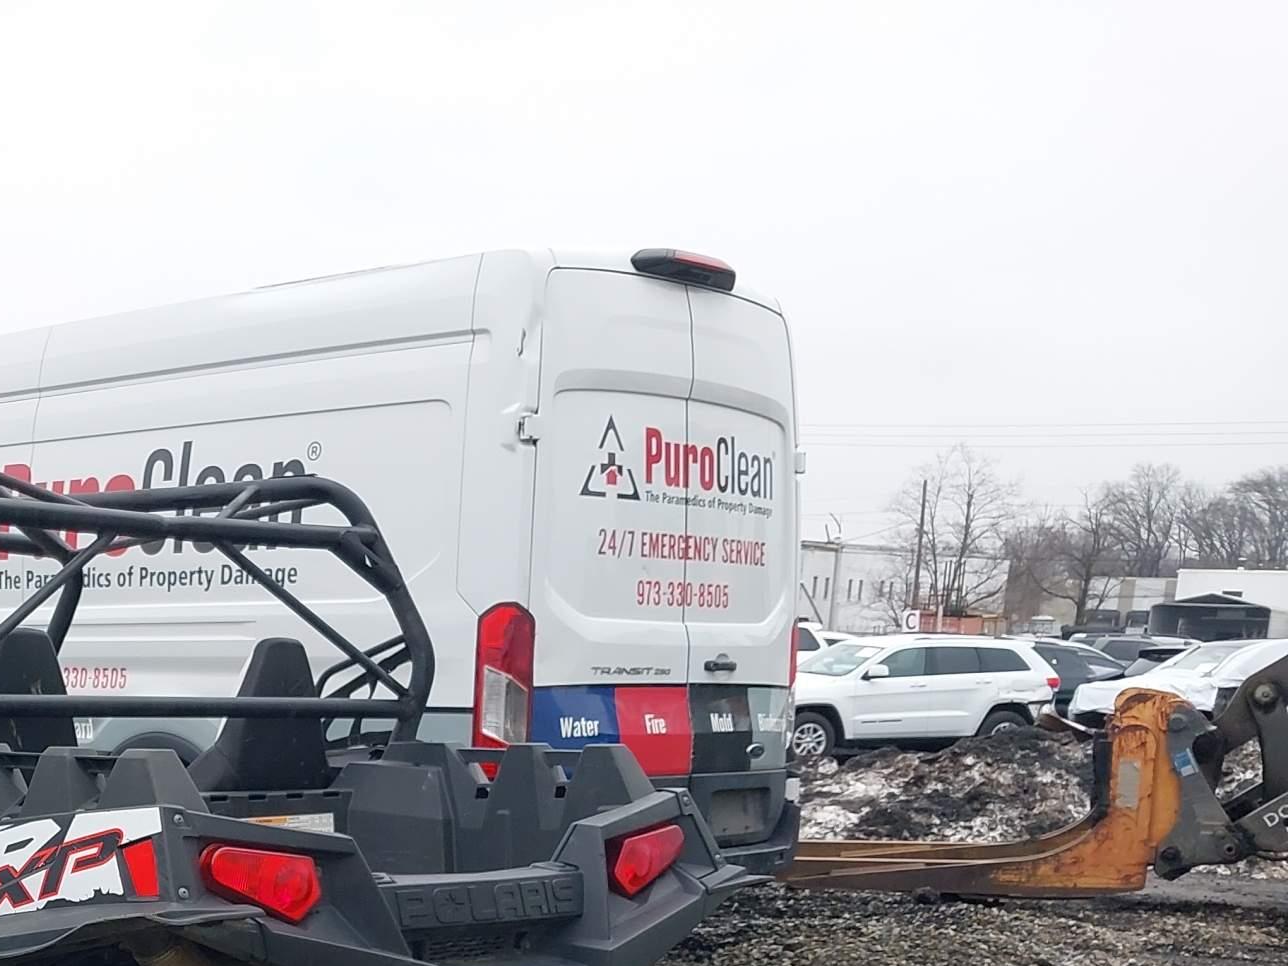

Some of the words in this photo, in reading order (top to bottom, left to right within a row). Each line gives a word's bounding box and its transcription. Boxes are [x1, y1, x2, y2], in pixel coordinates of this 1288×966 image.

[645, 427, 773, 500] PuroClean
[645, 490, 660, 504] The
[708, 497, 716, 509] of
[717, 499, 747, 515] Property
[598, 528, 635, 558] 24/7
[641, 532, 718, 562] EMERGENCY
[722, 538, 766, 567] SERVICE
[26, 567, 111, 589] Pardics
[117, 565, 134, 588] of
[139, 566, 214, 592] Property
[636, 580, 729, 608] 973-330-8505
[905, 613, 917, 630] C
[560, 717, 600, 738] Water
[644, 714, 667, 734] Fire
[710, 713, 734, 732] Mold
[395, 878, 578, 929] POLARIS
